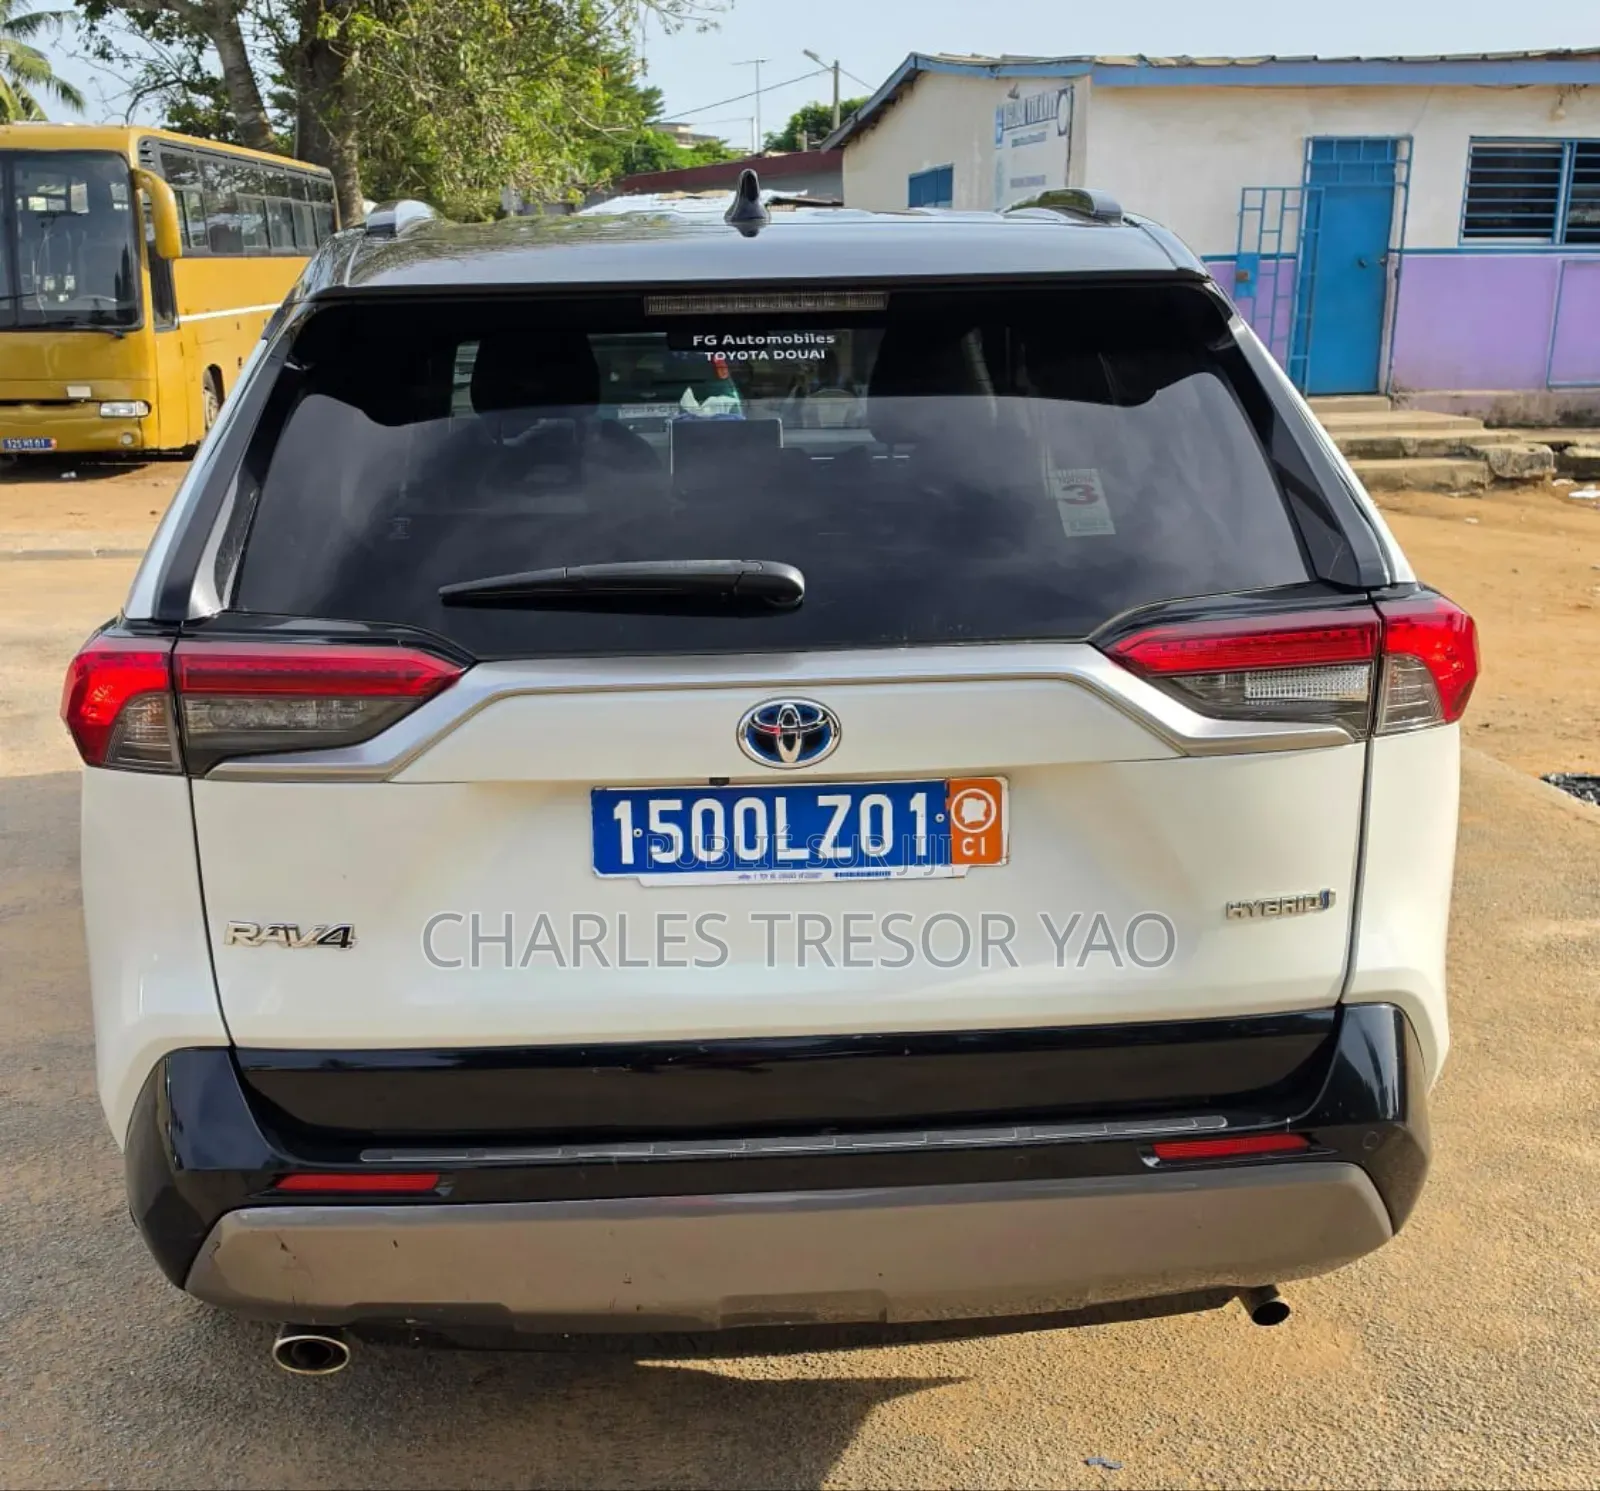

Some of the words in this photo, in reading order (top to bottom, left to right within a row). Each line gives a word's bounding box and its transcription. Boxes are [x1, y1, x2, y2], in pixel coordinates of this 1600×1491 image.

[693, 335, 717, 346] FG
[722, 333, 836, 345] Automobiles
[705, 351, 769, 361] TOYOTA
[774, 350, 825, 360] DOUAI
[613, 792, 928, 865] 1500LZ01
[962, 837, 986, 856] CI
[1226, 894, 1321, 921] HYBRID
[224, 920, 355, 951] RAV4
